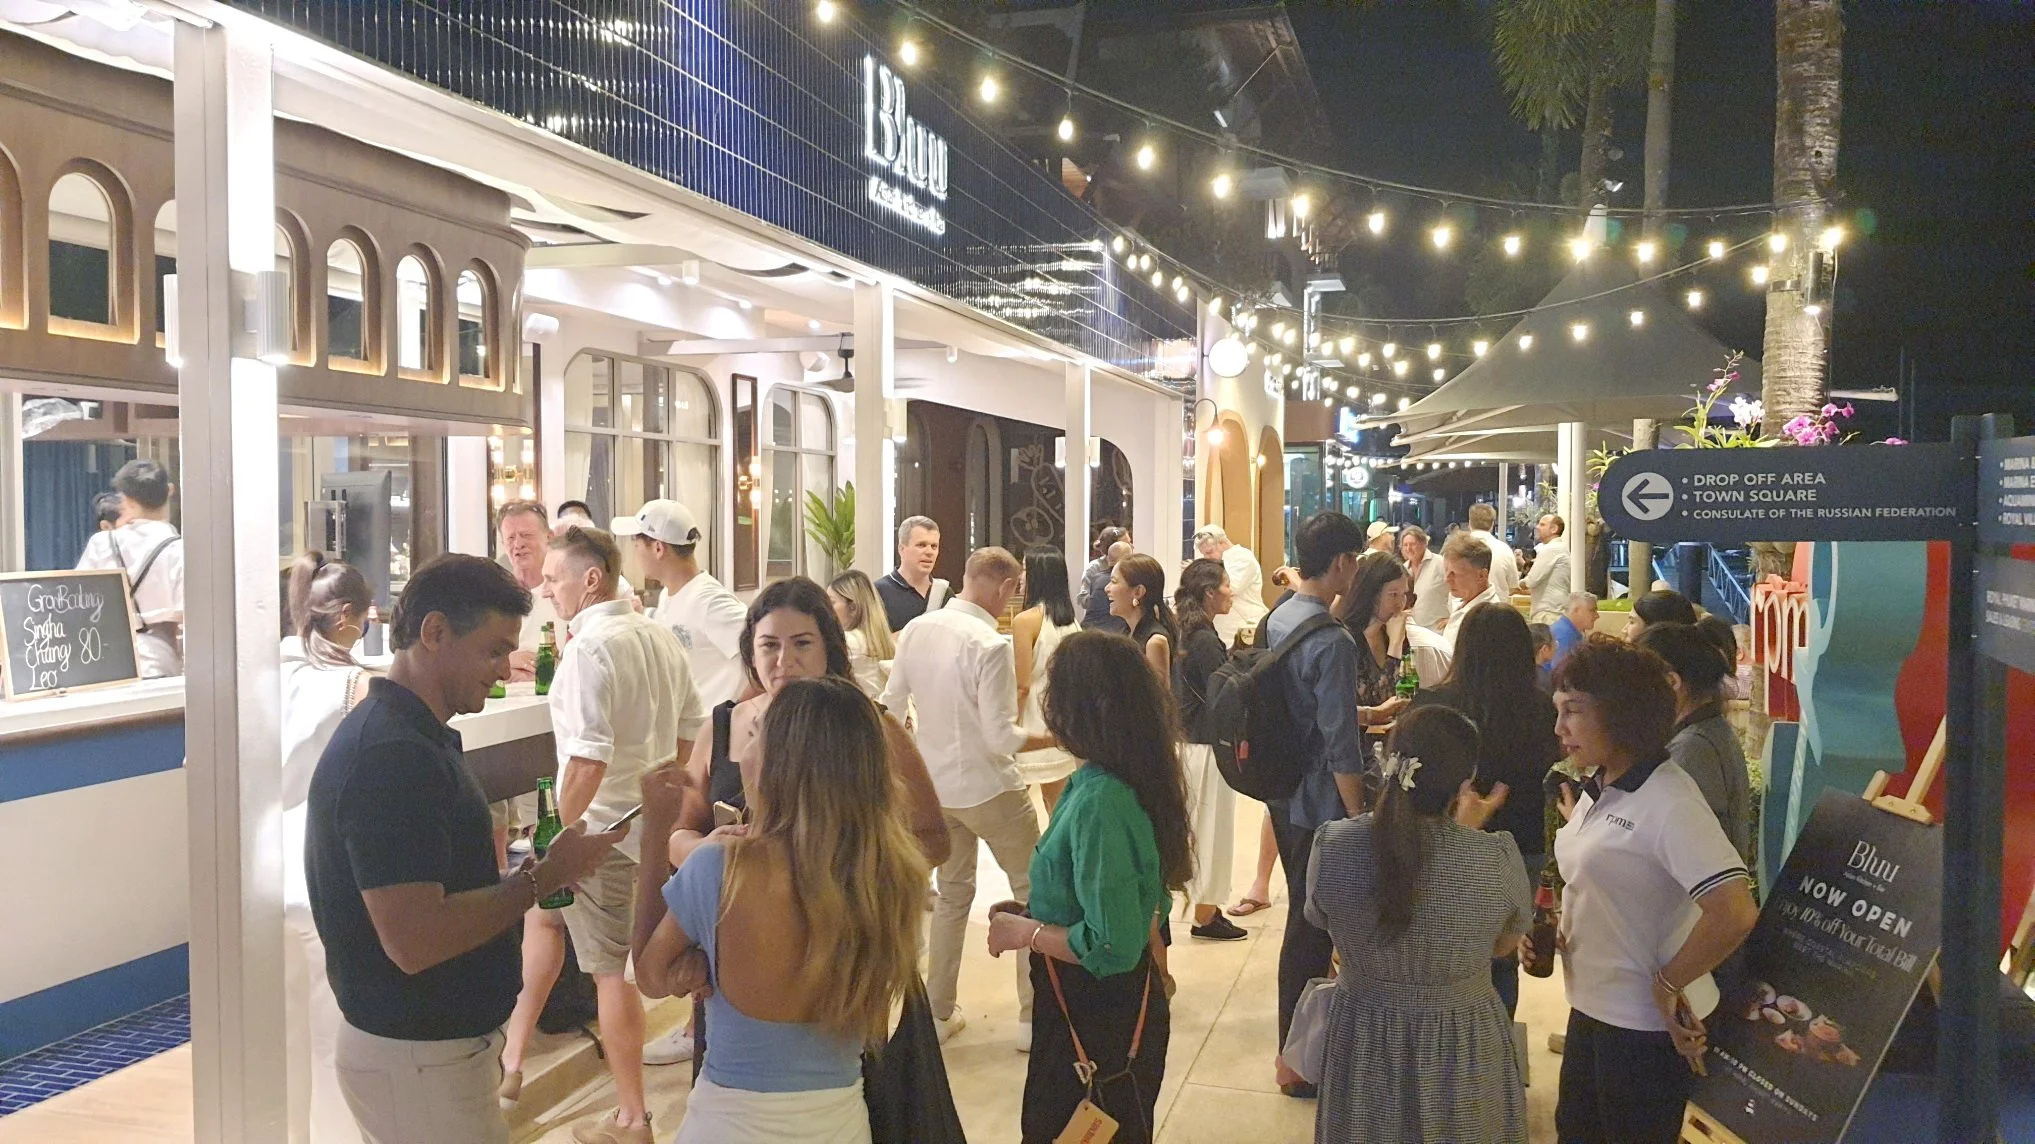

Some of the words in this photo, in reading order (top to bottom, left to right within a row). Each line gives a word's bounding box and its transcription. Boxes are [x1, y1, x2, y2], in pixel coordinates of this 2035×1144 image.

[865, 54, 948, 200] Bluu
[1693, 490, 1744, 502] TOWN
[1749, 489, 1817, 502] SQUARE
[1694, 474, 1739, 486] DROP
[1744, 473, 1776, 485] OFF
[1780, 472, 1826, 485] AREA
[1693, 509, 1766, 519] CONSULATE
[1769, 509, 1786, 518] OF
[1790, 508, 1814, 518] THE
[1817, 508, 1872, 518] RUSSIAN
[1875, 507, 1957, 517] FEDERATION
[23, 612, 67, 646] Singha
[25, 640, 72, 672] Chang
[1750, 585, 1809, 716] rpm
[28, 666, 58, 691] Leo
[1847, 840, 1900, 883] Bluu
[1799, 875, 1847, 907] NOW
[1851, 899, 1913, 938] OPEN
[1799, 906, 1822, 927] 10%
[1821, 917, 1843, 936] off
[1839, 923, 1867, 948] Your
[1865, 935, 1898, 963] Total
[1893, 949, 1918, 973] Bill
